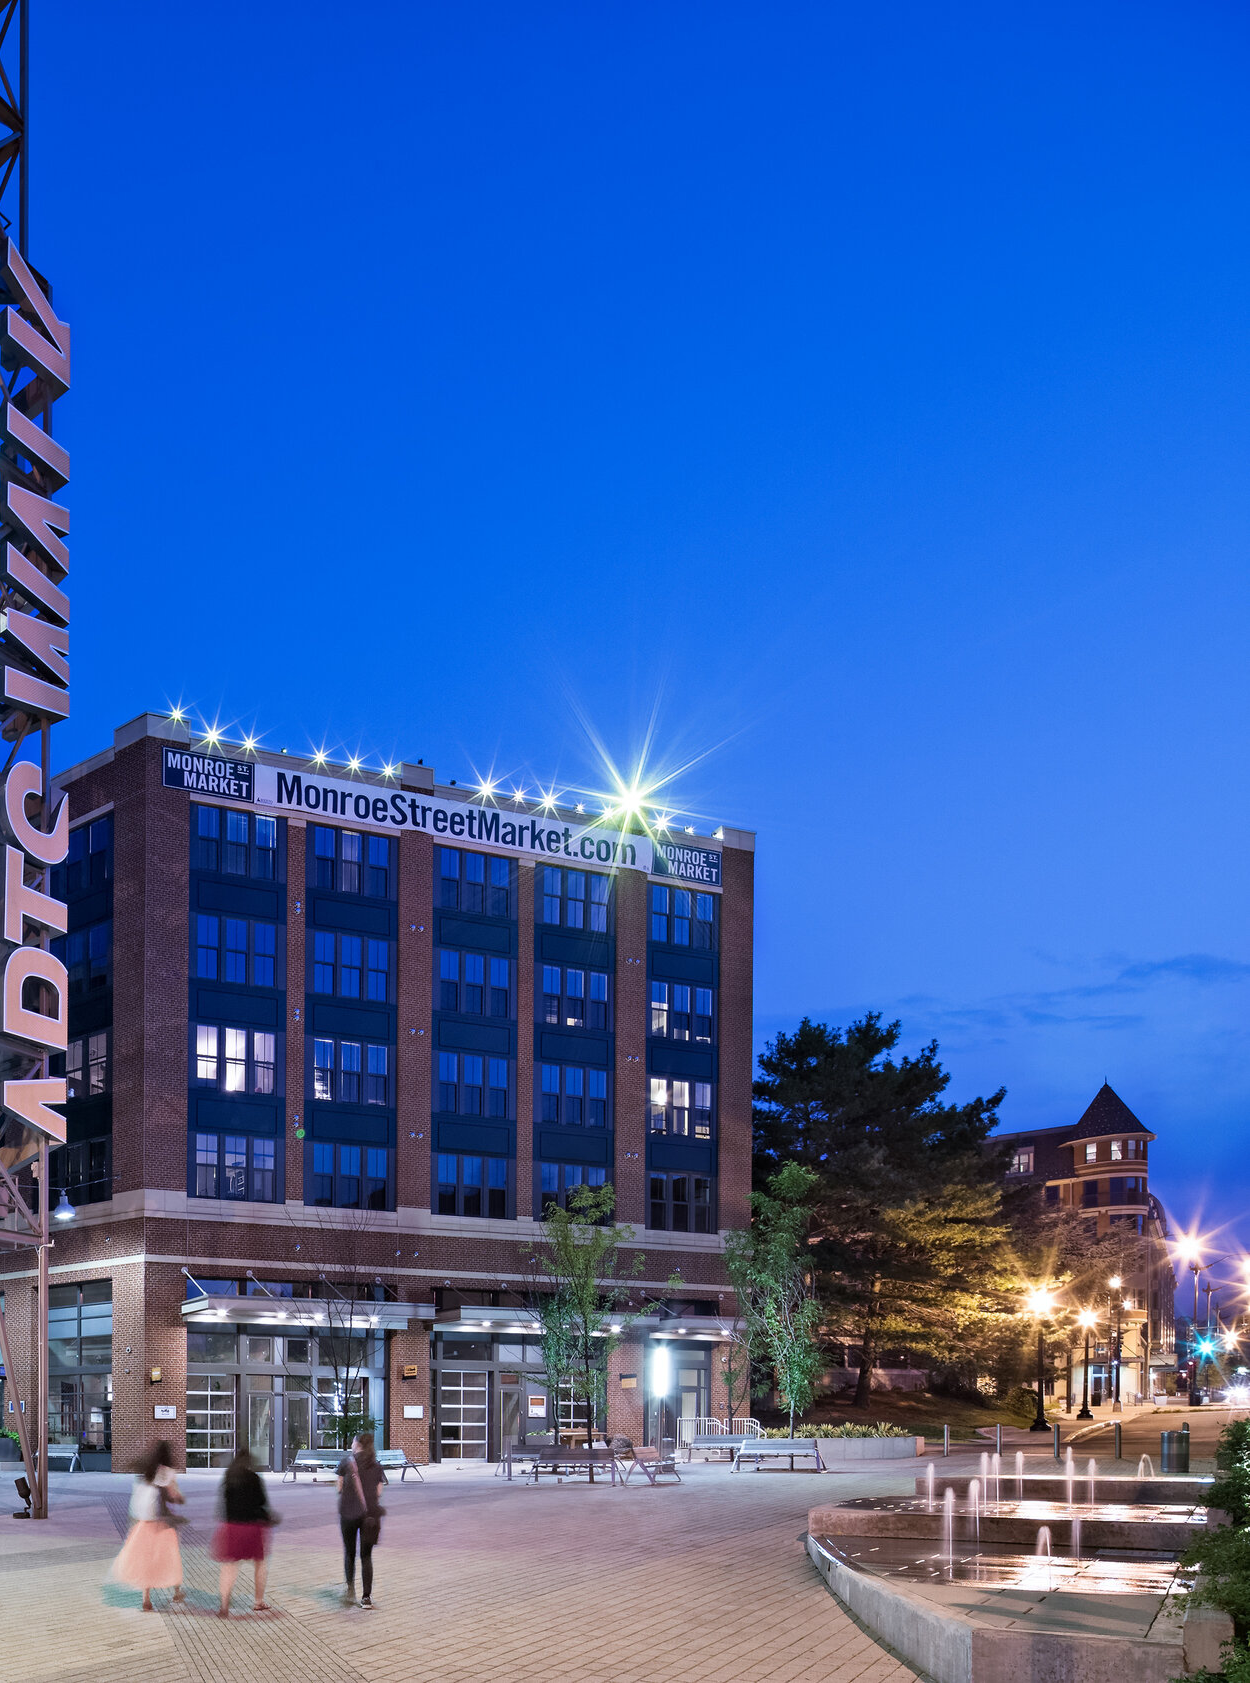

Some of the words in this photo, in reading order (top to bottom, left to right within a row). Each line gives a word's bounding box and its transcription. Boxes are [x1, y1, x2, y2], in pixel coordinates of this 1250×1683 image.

[167, 751, 235, 779] MONROE
[237, 764, 249, 775] ST.
[183, 771, 249, 797] MARKET
[276, 771, 636, 866] MonroeStreetMarket.com
[656, 843, 707, 866] MONROE
[667, 860, 718, 882] MARKET
